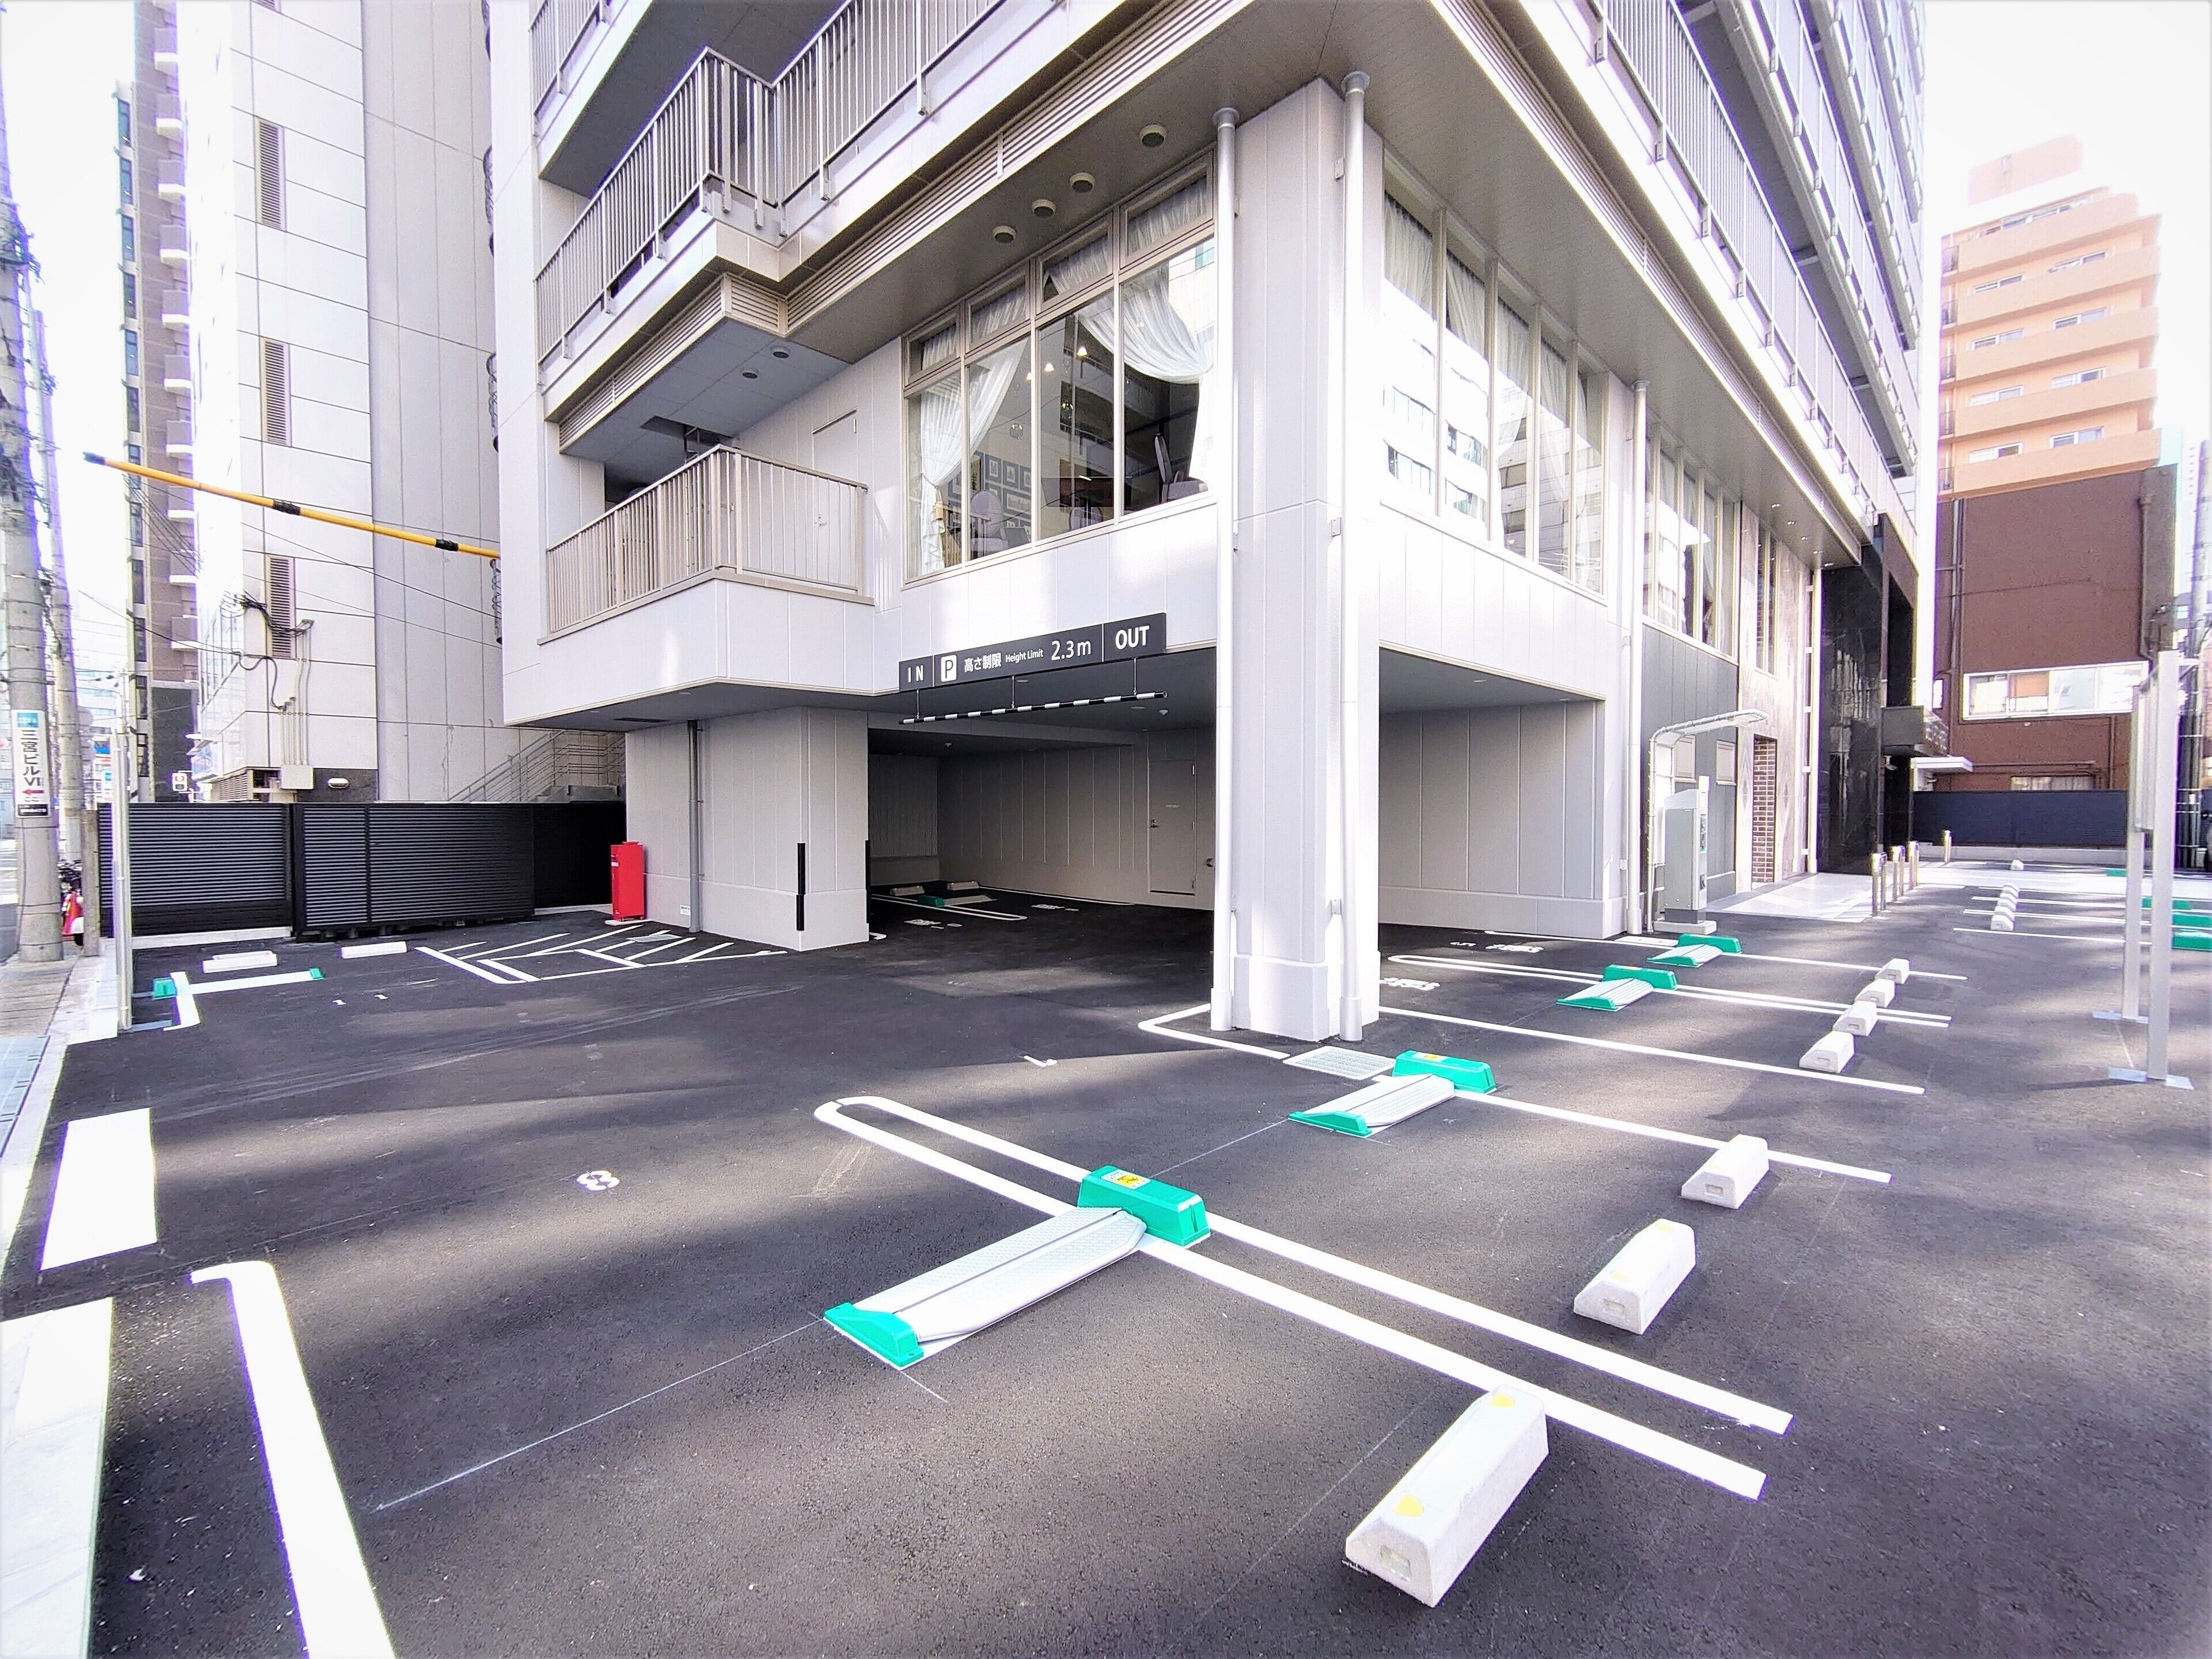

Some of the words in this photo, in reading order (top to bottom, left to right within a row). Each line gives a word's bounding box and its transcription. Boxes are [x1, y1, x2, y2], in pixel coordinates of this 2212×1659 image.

[1115, 625, 1150, 650] OUT
[964, 652, 1002, 673] 高さ制限
[1005, 652, 1027, 664] Height
[1027, 648, 1044, 660] Limit
[908, 665, 925, 683] IN
